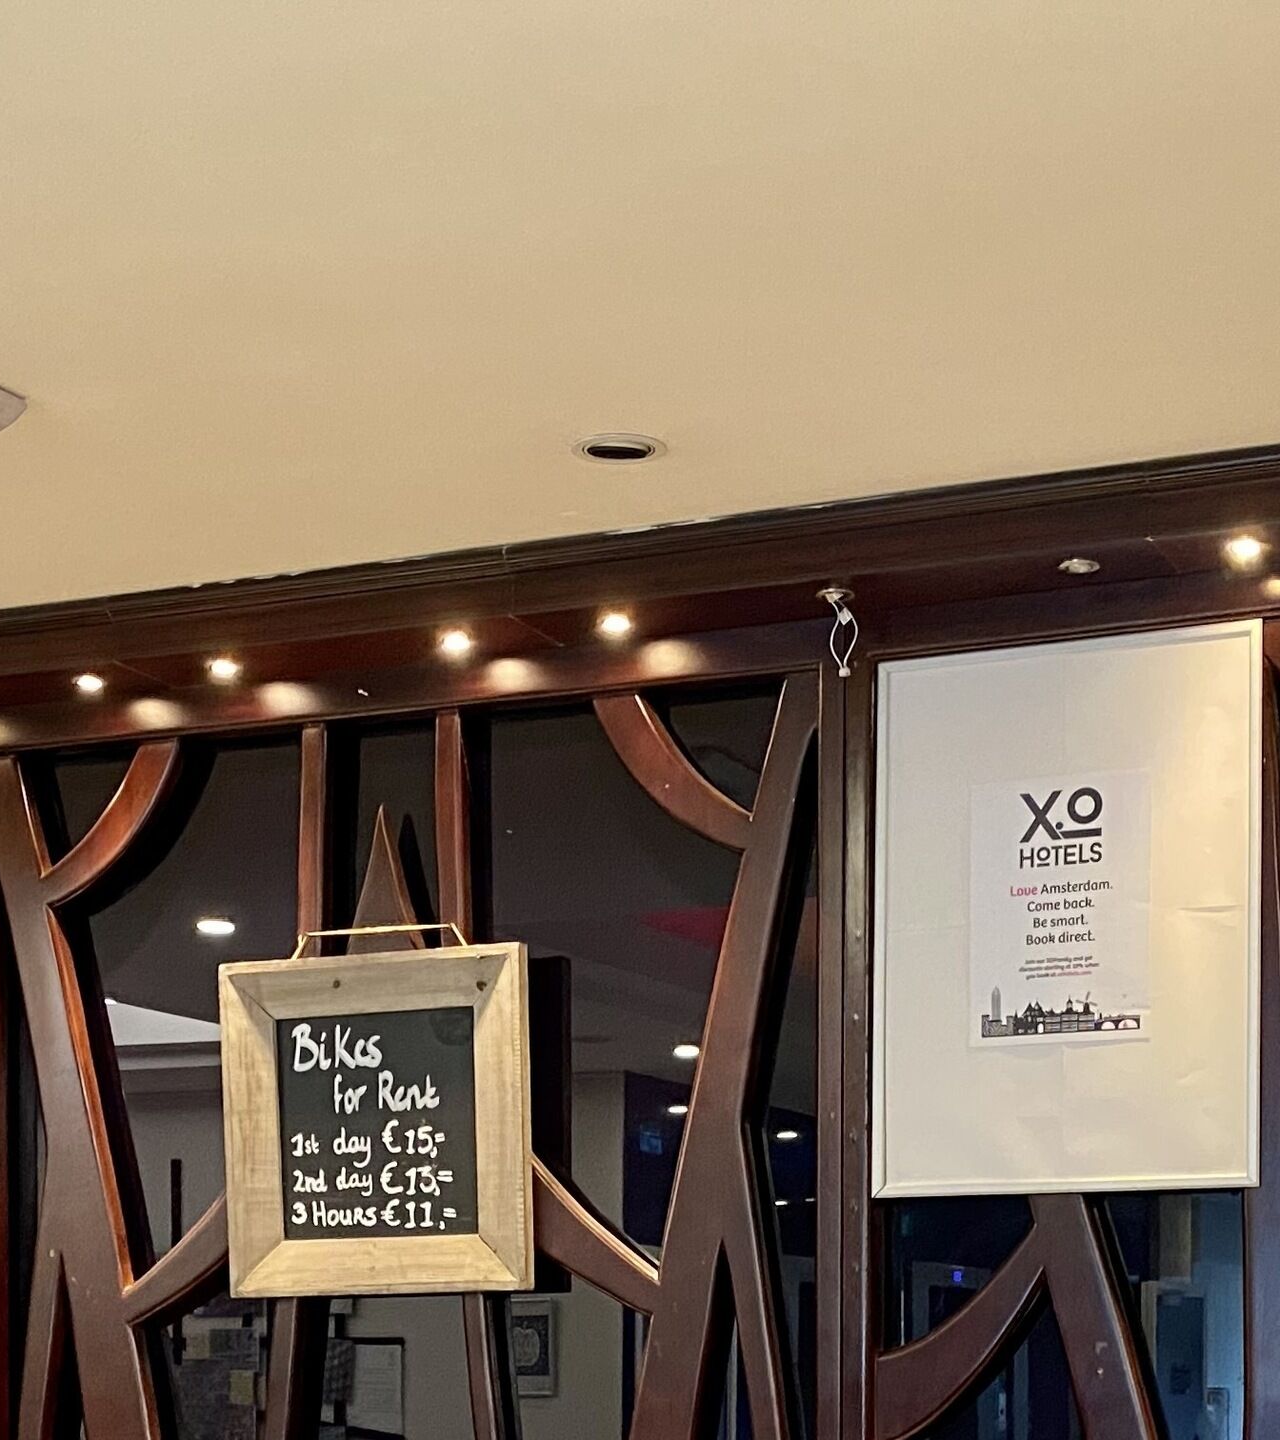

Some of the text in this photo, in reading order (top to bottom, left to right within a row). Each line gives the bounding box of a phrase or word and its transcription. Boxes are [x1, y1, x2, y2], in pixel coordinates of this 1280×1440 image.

[1010, 880, 1113, 897] Love Amsterdam.
[1027, 897, 1095, 912] Come back.
[1033, 914, 1088, 928] Be smart.
[1026, 930, 1095, 945] Book direct.
[378, 1069, 440, 1113] Rent
[290, 1131, 320, 1157] 1st
[332, 1126, 372, 1169] day
[292, 1168, 328, 1193] 2nd
[335, 1166, 373, 1197] day
[291, 1201, 308, 1225] 3
